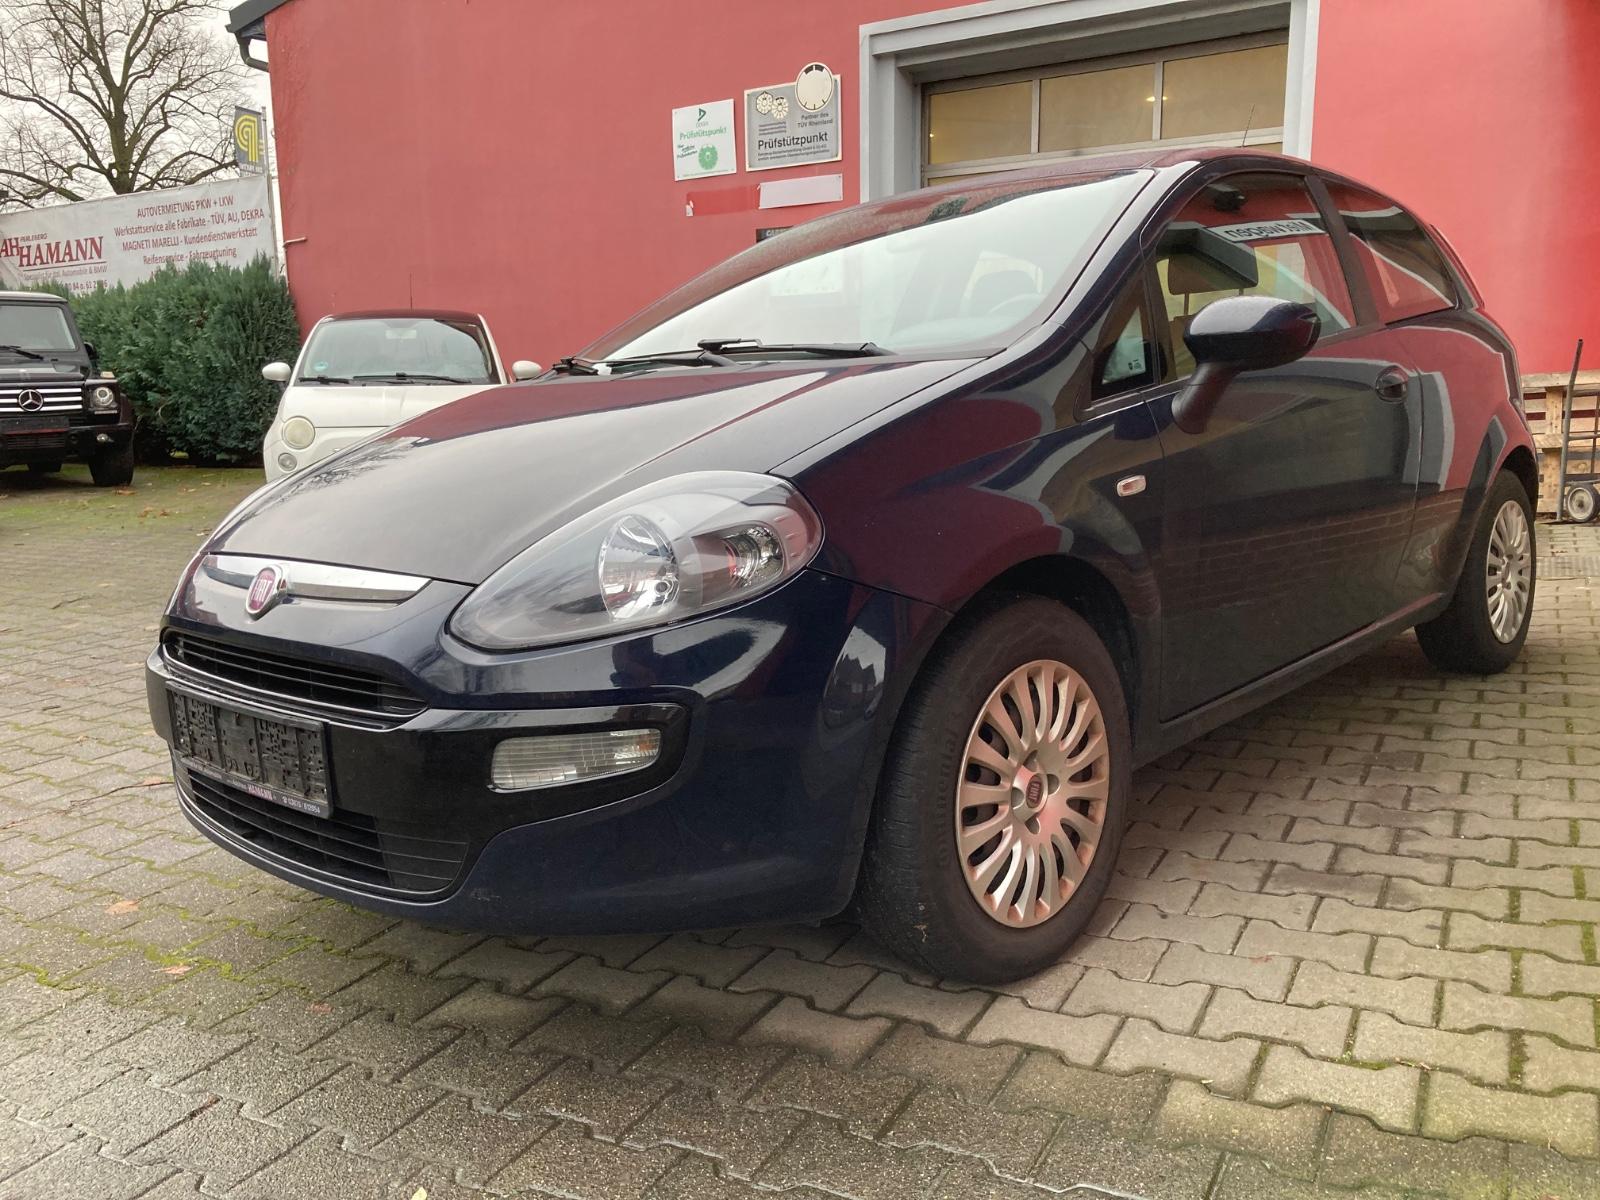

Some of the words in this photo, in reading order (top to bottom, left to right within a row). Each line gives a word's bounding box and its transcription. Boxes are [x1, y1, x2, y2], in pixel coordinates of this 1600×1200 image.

[809, 119, 833, 127] Rheinland
[757, 131, 829, 150] Prüfstützpunkt
[137, 200, 195, 218] AUTOVERMIETUNG
[196, 198, 212, 209] PKW
[218, 195, 234, 207] LKW
[114, 223, 164, 237] Werkstattservice
[165, 221, 176, 231] alle
[177, 216, 206, 230] Fabrikate
[211, 211, 227, 226] TÜV,
[228, 211, 240, 223] AU,
[241, 207, 265, 221] DEKRA
[122, 239, 151, 252] MAGNETI
[152, 236, 179, 249] MARELLI
[184, 226, 258, 245] Kundendienstwerkstatt
[18, 236, 104, 268] HAMANN
[189, 246, 237, 261] Fahrzeugtuning
[251, 579, 273, 603] FIAT
